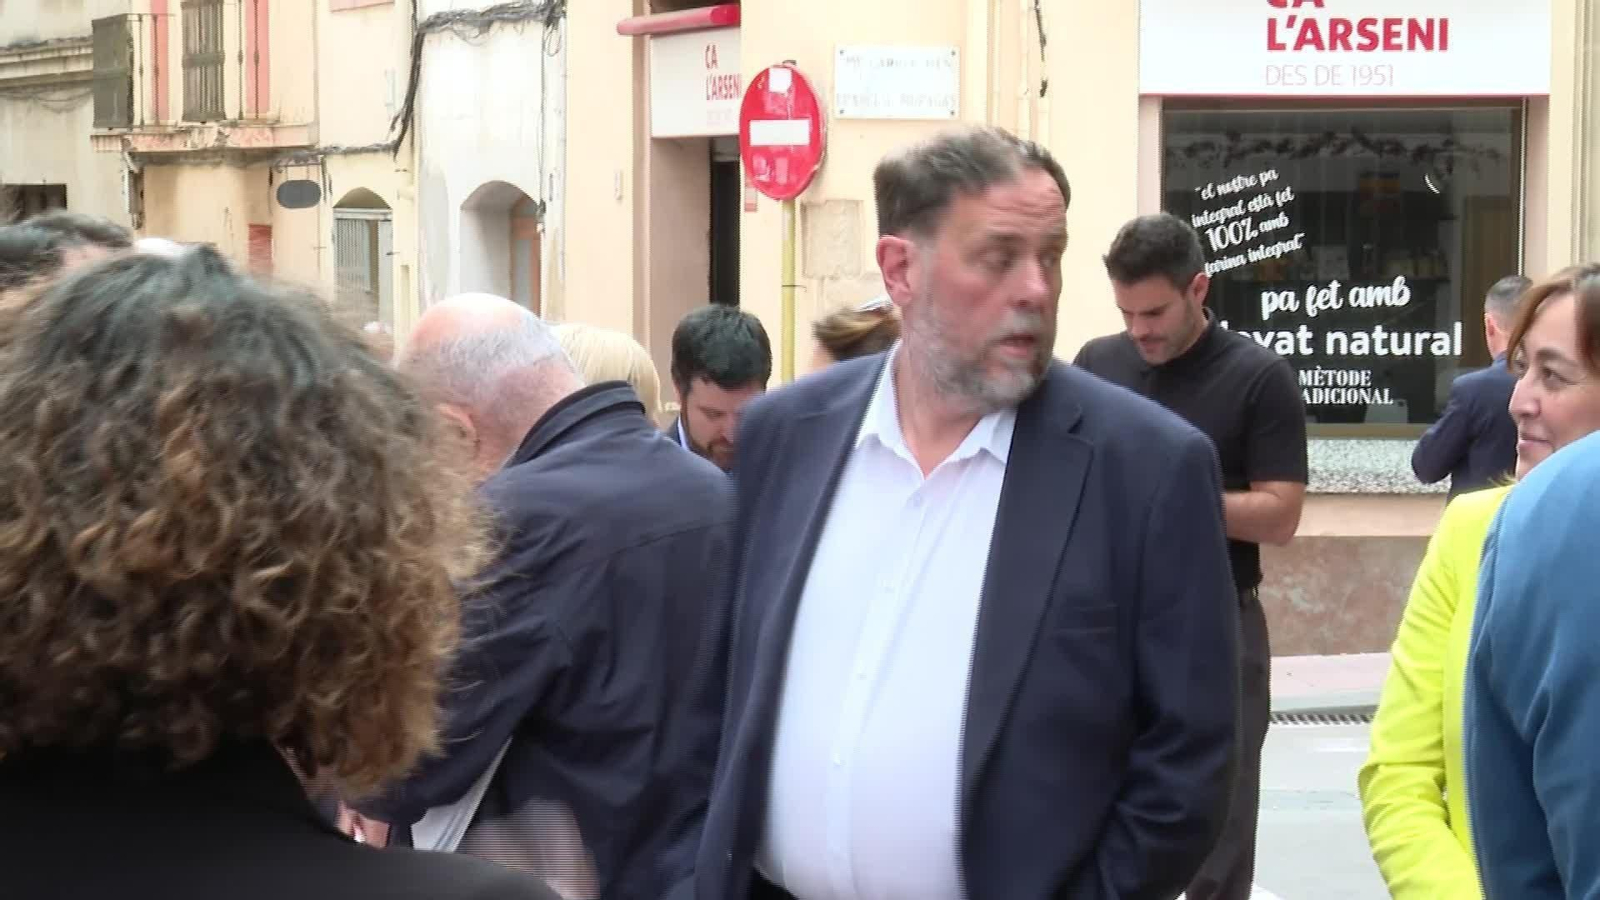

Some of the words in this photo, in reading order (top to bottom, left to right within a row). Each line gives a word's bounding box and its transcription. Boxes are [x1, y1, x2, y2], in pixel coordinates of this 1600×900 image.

[1266, 15, 1449, 51] L'ARSENI
[705, 44, 718, 69] CA
[1265, 64, 1308, 86] DES
[1314, 64, 1343, 86] DE
[1351, 63, 1394, 86] 1951
[1258, 169, 1279, 188] pa
[1191, 199, 1246, 228] integral
[1274, 185, 1295, 208] fet
[1204, 216, 1259, 252] 100%
[1258, 211, 1290, 233] amb
[1260, 289, 1300, 321] pa
[1305, 279, 1344, 318] fet
[1348, 275, 1411, 308] amb
[1325, 321, 1463, 356] natural
[1298, 365, 1372, 387] MÈTODE
[1302, 387, 1394, 405] ADICIONAL
